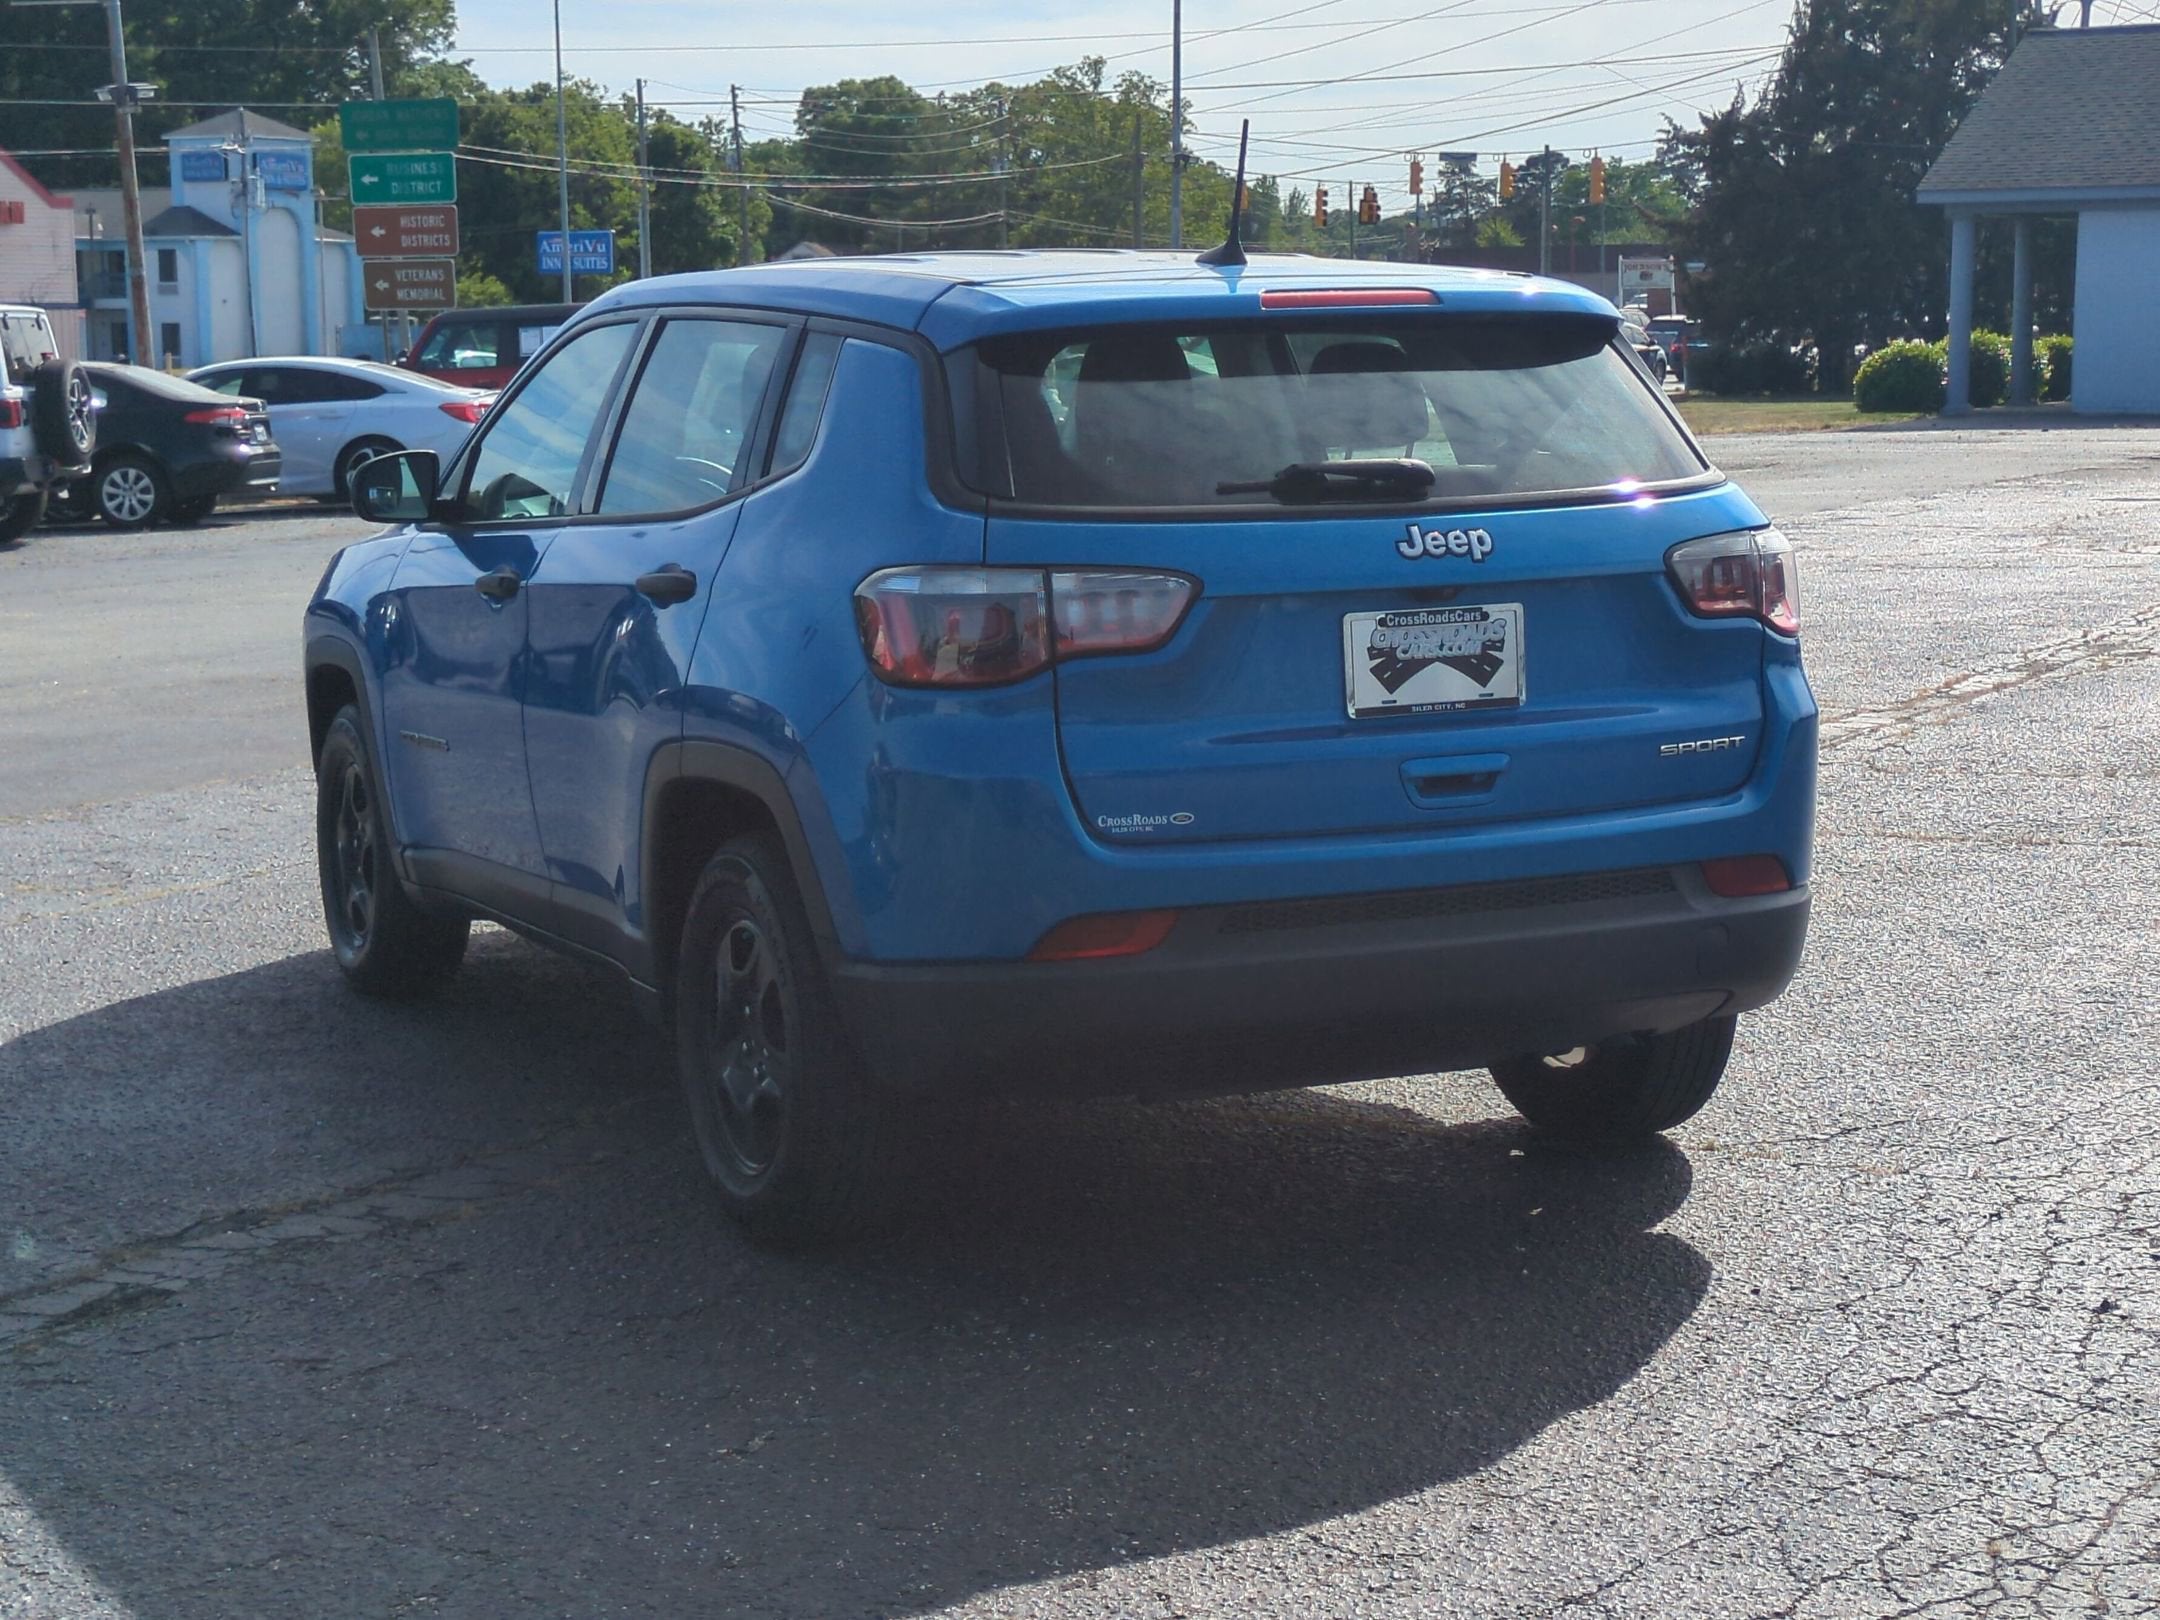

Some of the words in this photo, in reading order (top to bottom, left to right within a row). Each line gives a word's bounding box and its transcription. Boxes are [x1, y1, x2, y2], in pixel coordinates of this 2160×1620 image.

[391, 181, 442, 195] DISTRICT
[400, 215, 446, 229] HISTORIC
[400, 234, 451, 248] DISTRICTS
[541, 256, 562, 271] INN
[572, 256, 608, 270] SUITES
[394, 268, 446, 282] VETERANS
[396, 287, 446, 301] MEMORIAL
[1397, 524, 1493, 561] Jeep
[1386, 610, 1482, 627] CrossRoadsCars
[1411, 704, 1433, 713] SILER
[1455, 702, 1466, 710] NC
[1660, 735, 1746, 757] SPORT
